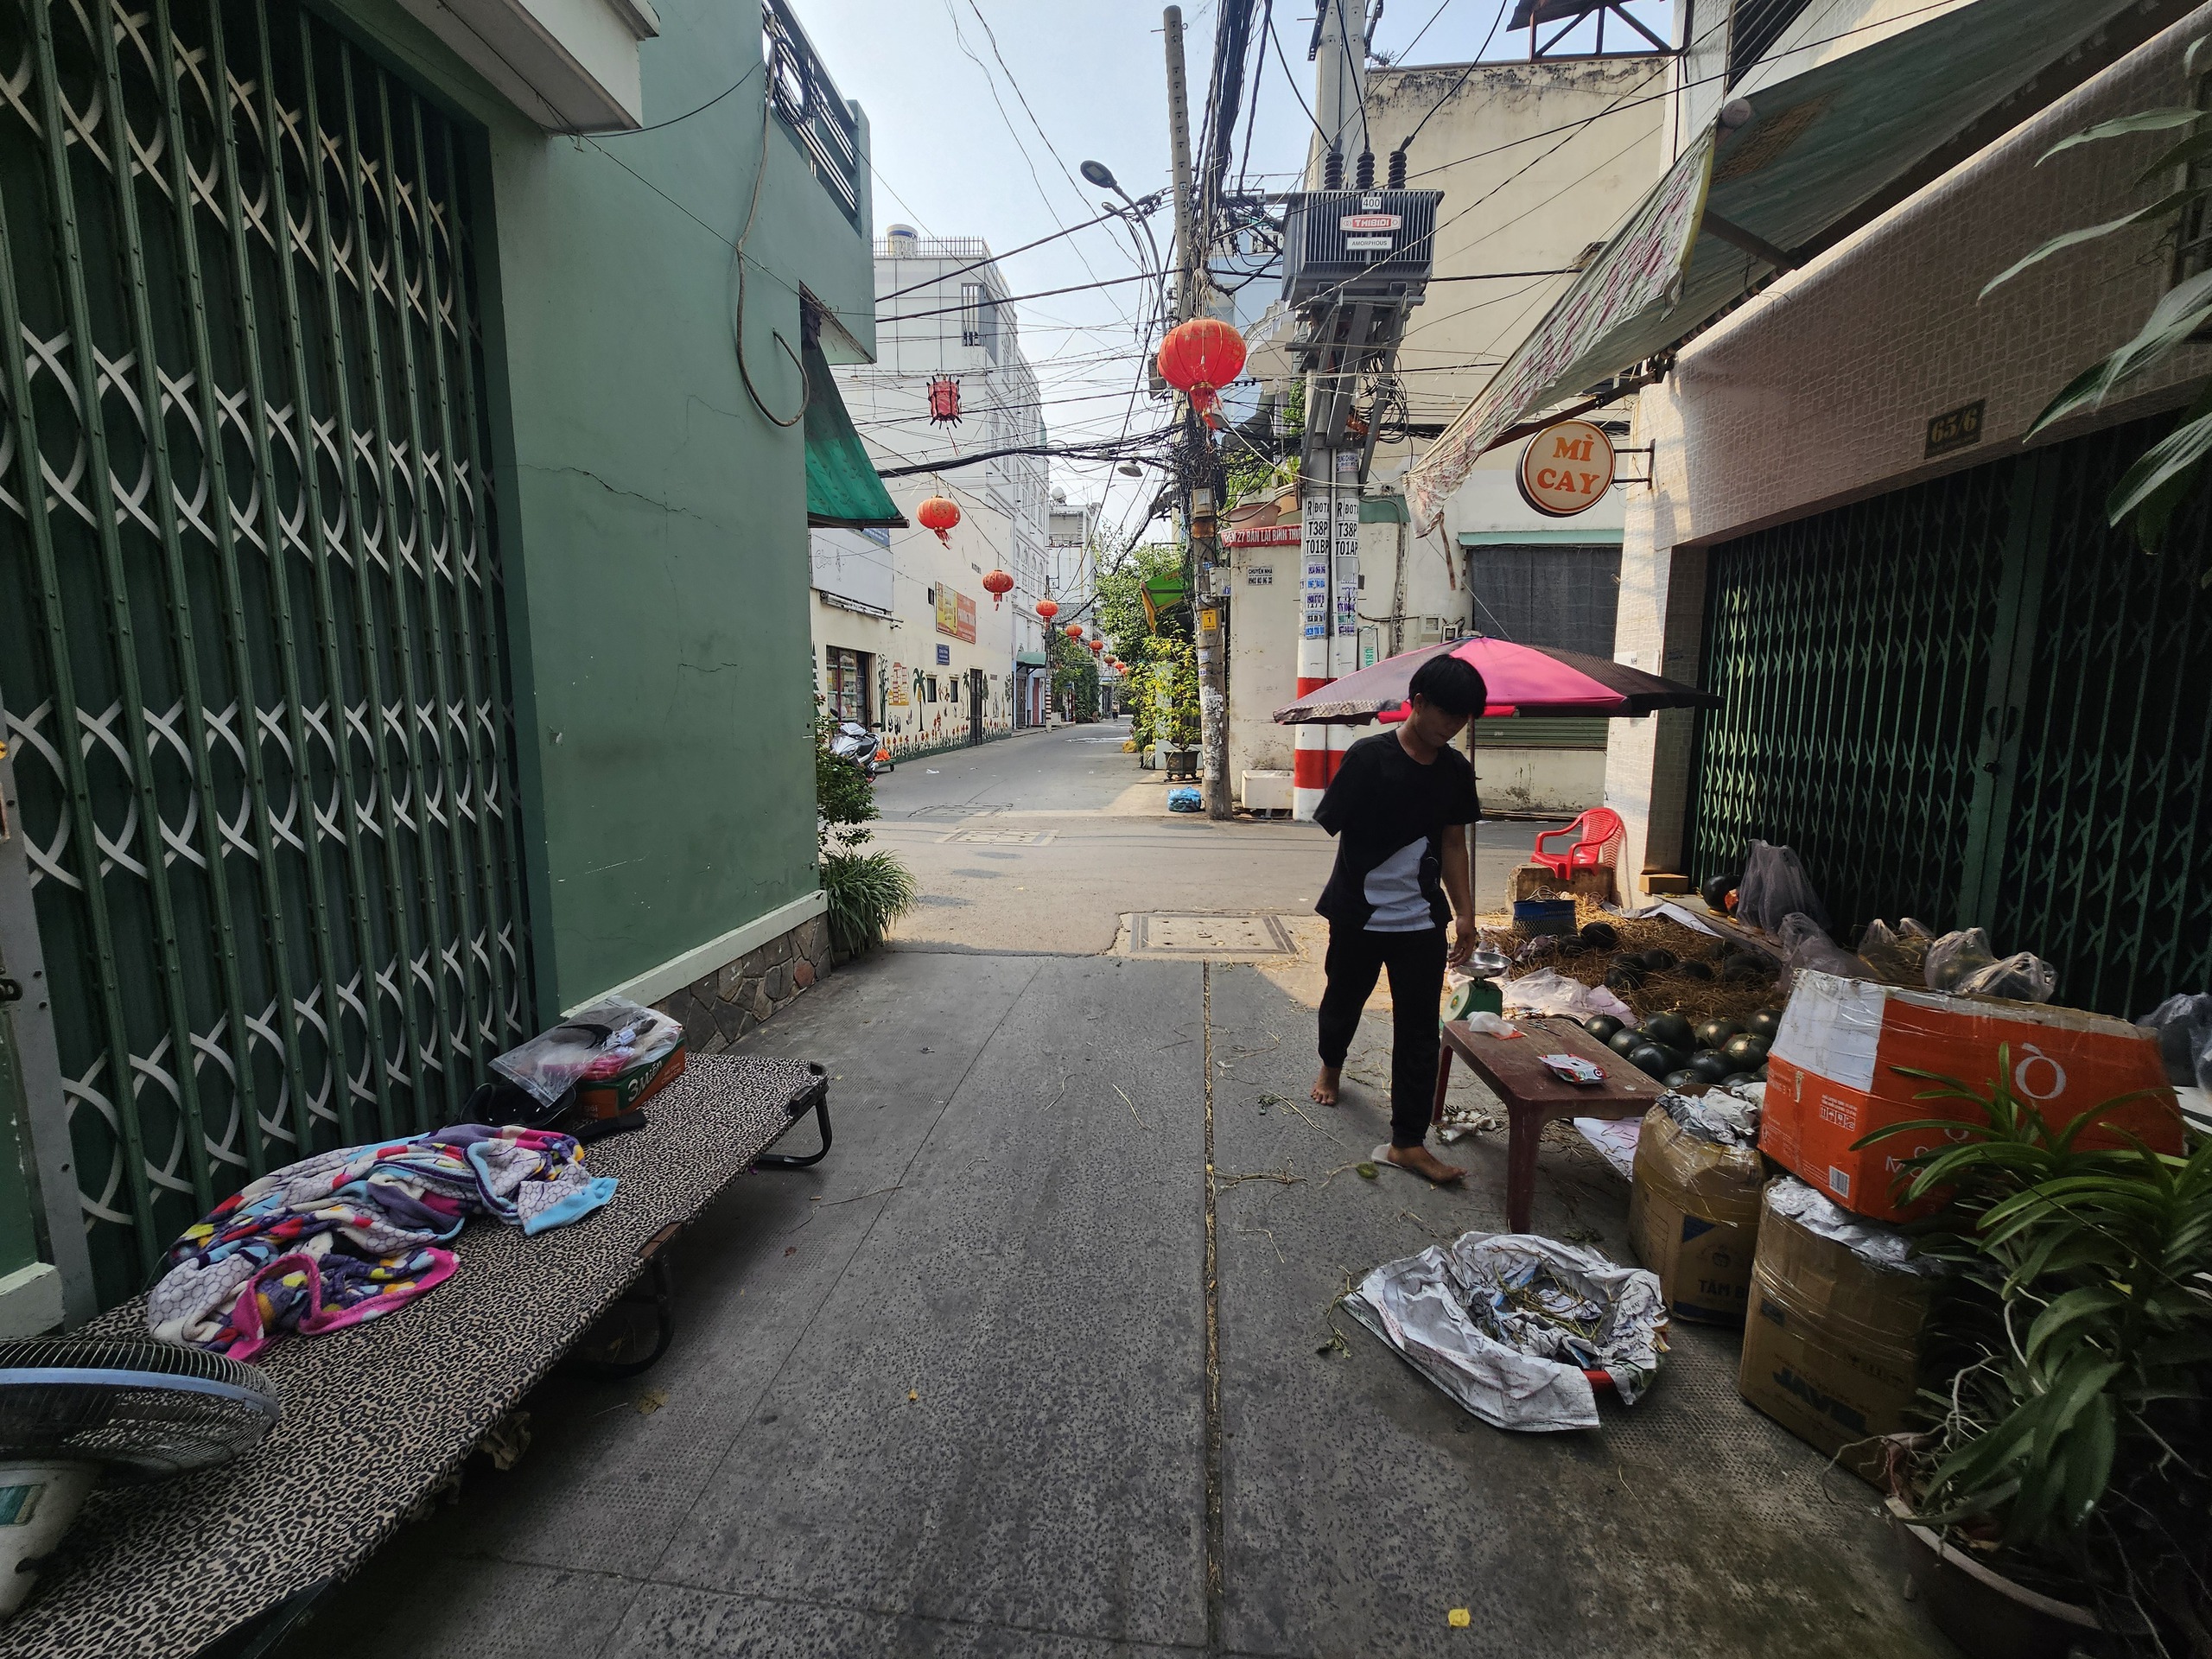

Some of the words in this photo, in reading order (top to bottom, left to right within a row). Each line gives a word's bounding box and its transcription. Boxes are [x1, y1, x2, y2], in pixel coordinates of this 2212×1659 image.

[1363, 198, 1380, 207] 400
[1354, 219, 1389, 227] THIBIDI
[1930, 408, 1978, 443] 65/6
[1552, 434, 1595, 461] MÌ
[1536, 467, 1600, 494] CAY
[1307, 501, 1312, 516] R
[1337, 502, 1342, 517] R
[1308, 520, 1328, 537] T38P
[1338, 522, 1357, 537] T38P
[1306, 539, 1329, 555] T01BP
[1336, 541, 1357, 556] T01AP
